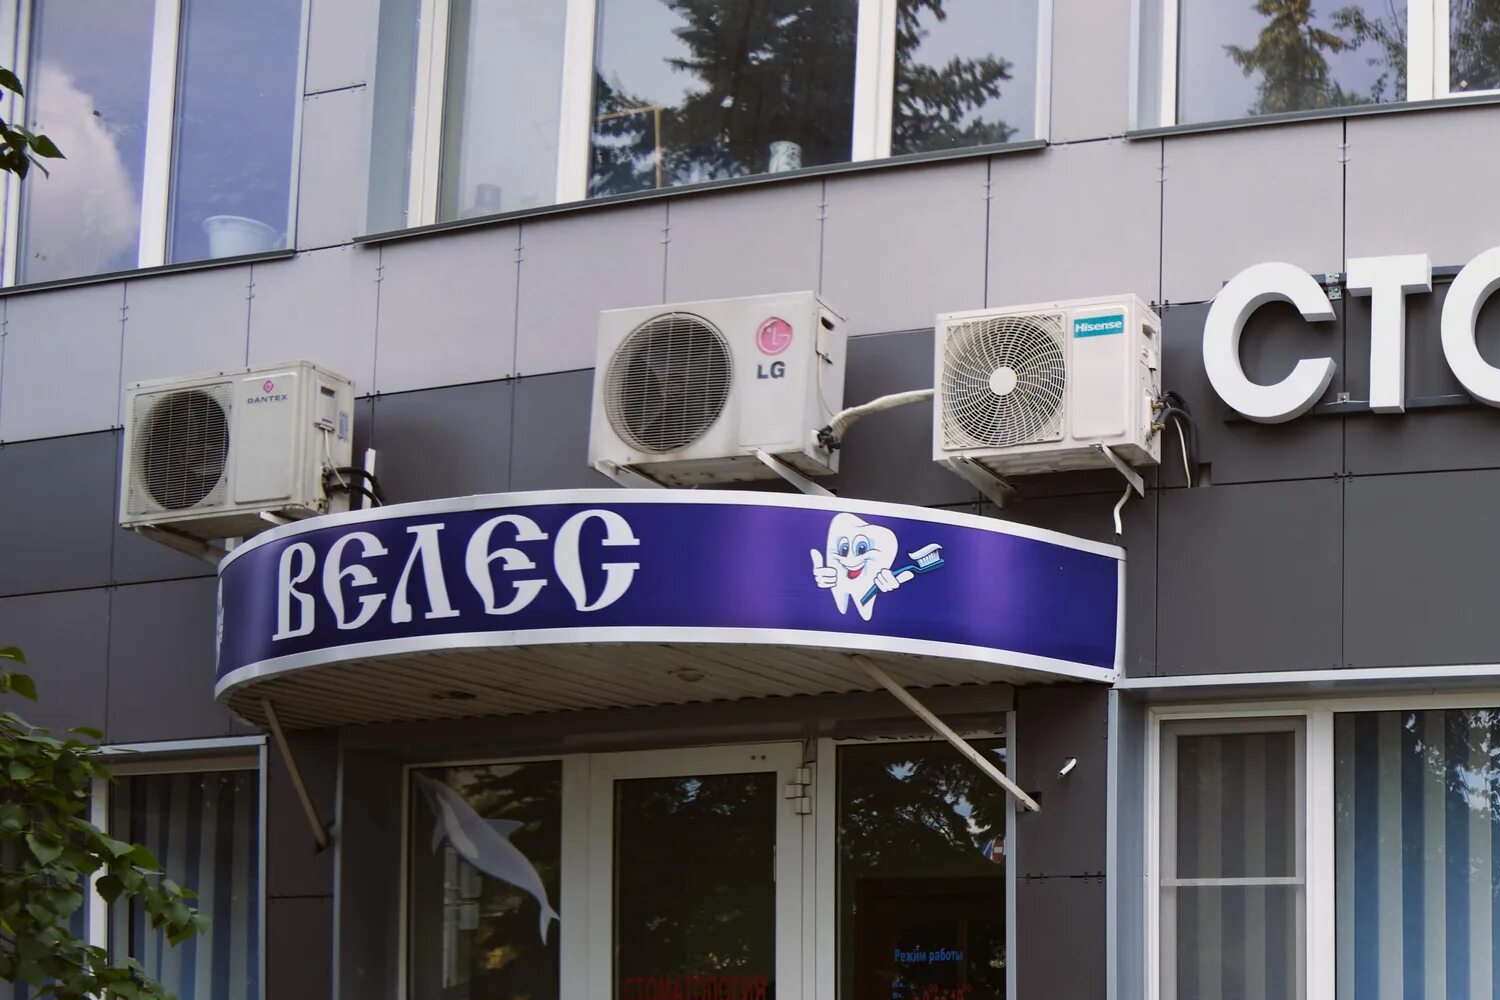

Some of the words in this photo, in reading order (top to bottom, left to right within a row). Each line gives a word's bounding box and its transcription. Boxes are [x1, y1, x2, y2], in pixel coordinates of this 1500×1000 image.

[1075, 320, 1122, 333] Hisense
[757, 361, 786, 379] LG
[247, 394, 288, 404] DANTEX
[272, 509, 641, 642] ВЕЛЕС
[894, 948, 927, 963] Режим
[928, 948, 963, 964] работы
